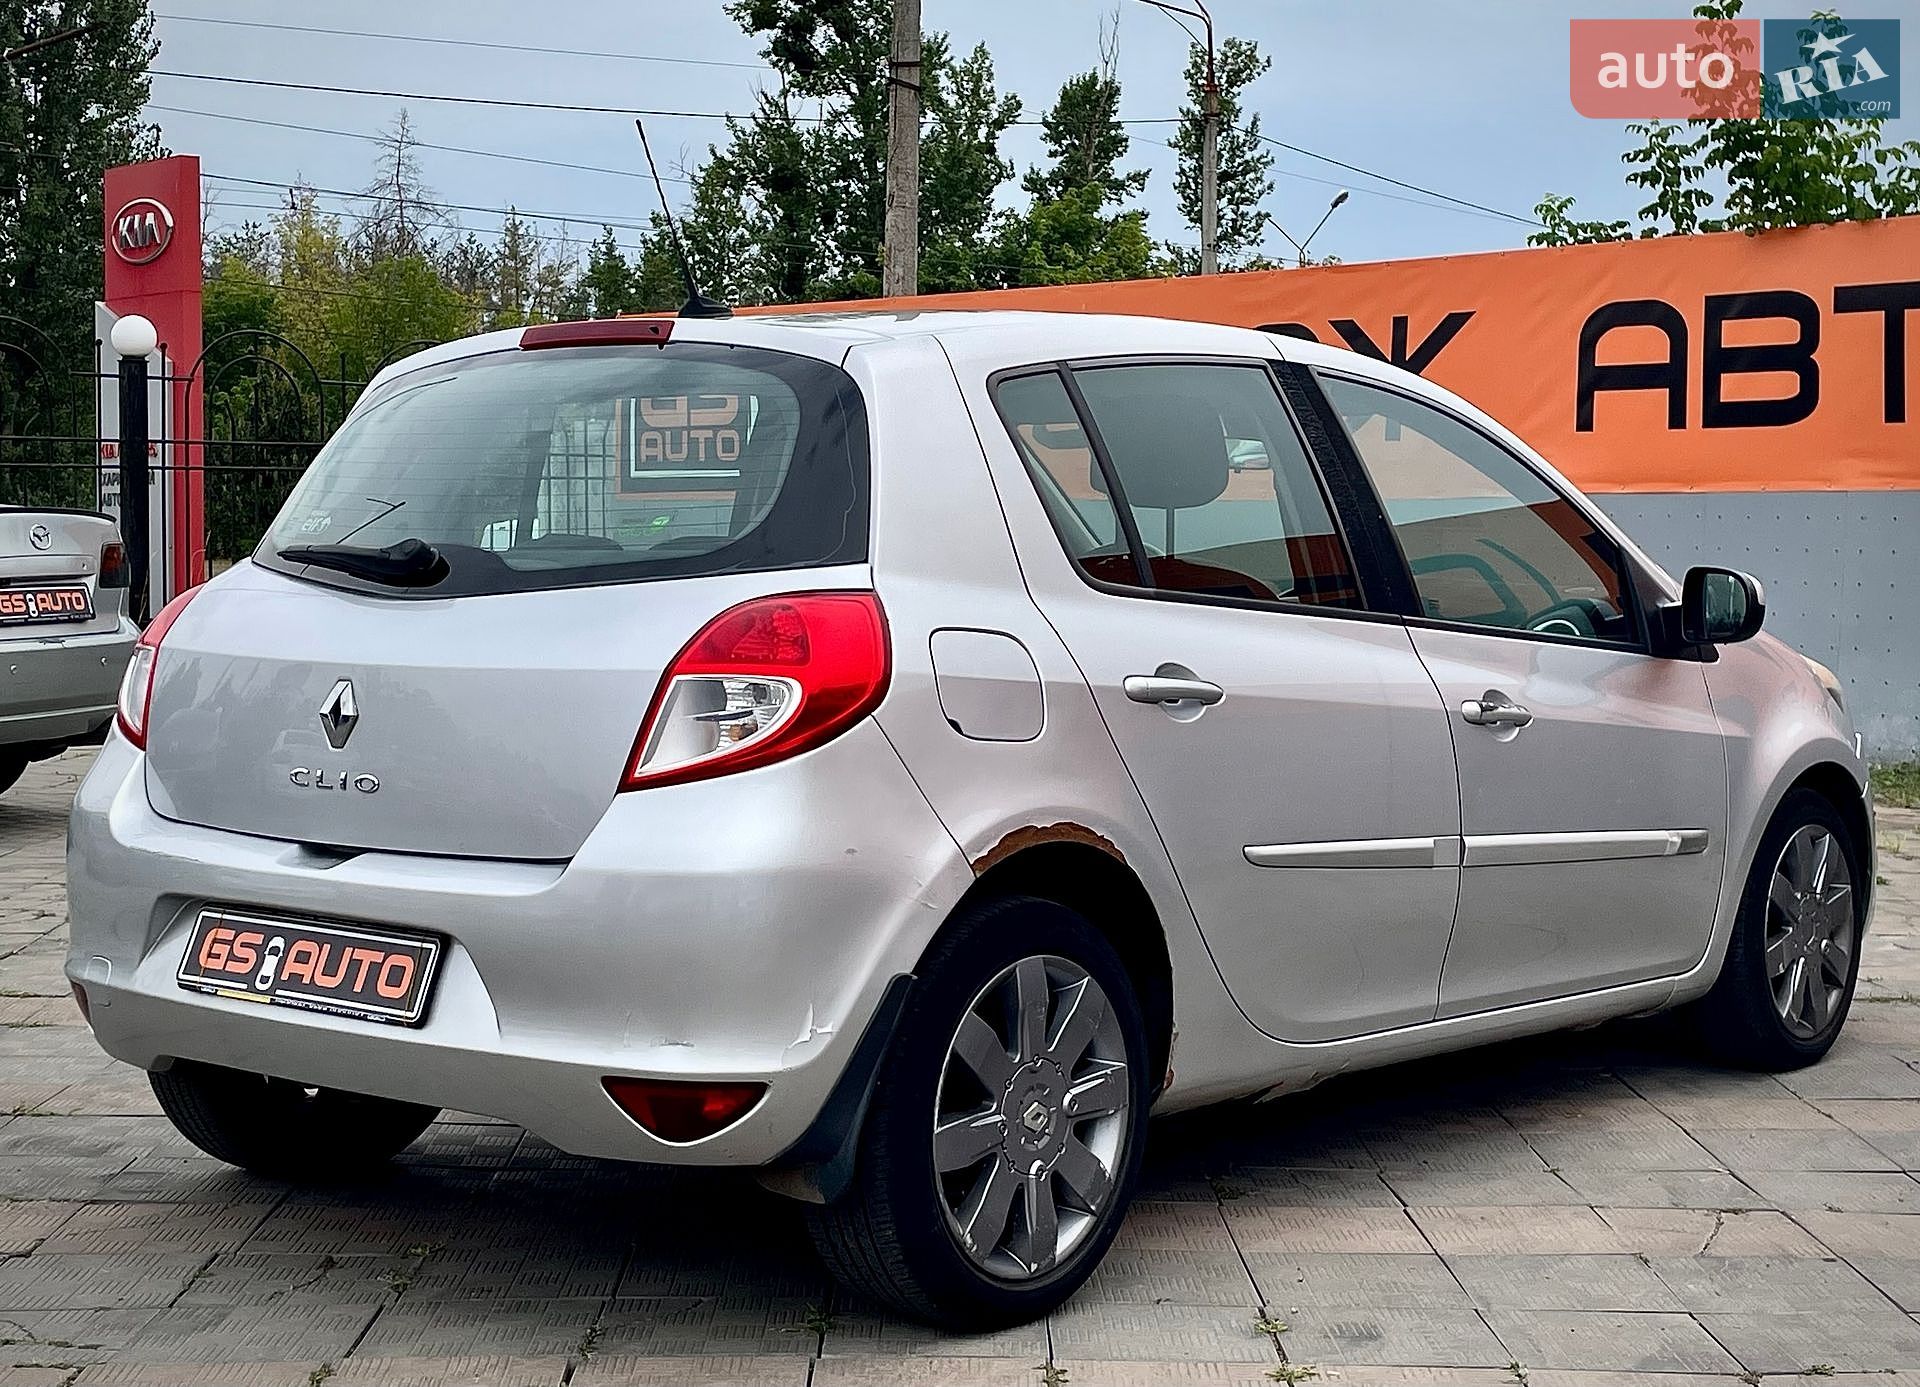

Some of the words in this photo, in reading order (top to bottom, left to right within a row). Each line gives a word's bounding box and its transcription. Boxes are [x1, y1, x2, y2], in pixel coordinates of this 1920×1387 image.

[118, 211, 161, 251] KIA
[640, 429, 741, 463] AUTO
[0, 593, 26, 614] GS
[36, 592, 85, 612] AUTO
[289, 766, 381, 794] CLIO
[198, 927, 265, 975] GS
[280, 938, 416, 999] AUTO
